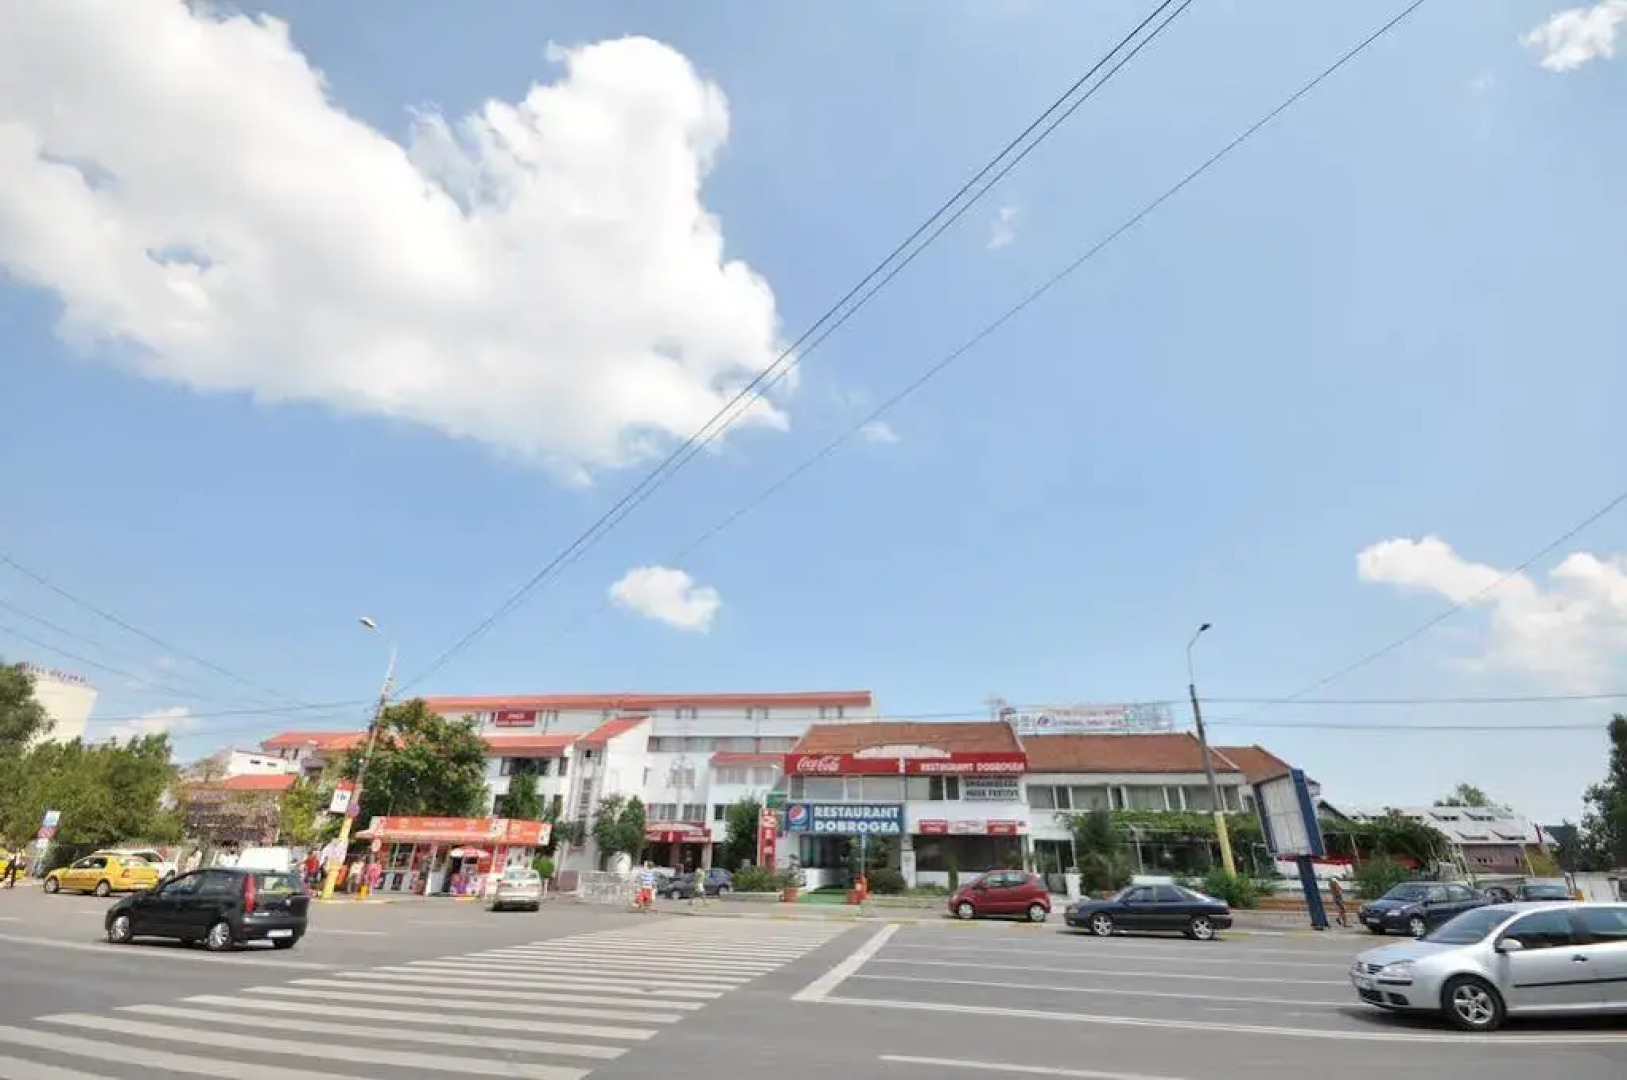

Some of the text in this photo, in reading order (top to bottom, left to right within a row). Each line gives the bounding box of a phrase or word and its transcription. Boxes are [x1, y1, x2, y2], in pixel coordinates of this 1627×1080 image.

[797, 755, 840, 773] Coca-Cola
[920, 762, 973, 771] RESTAURANT
[814, 806, 899, 818] RESTAURANT
[815, 821, 900, 833] DOBROGEA
